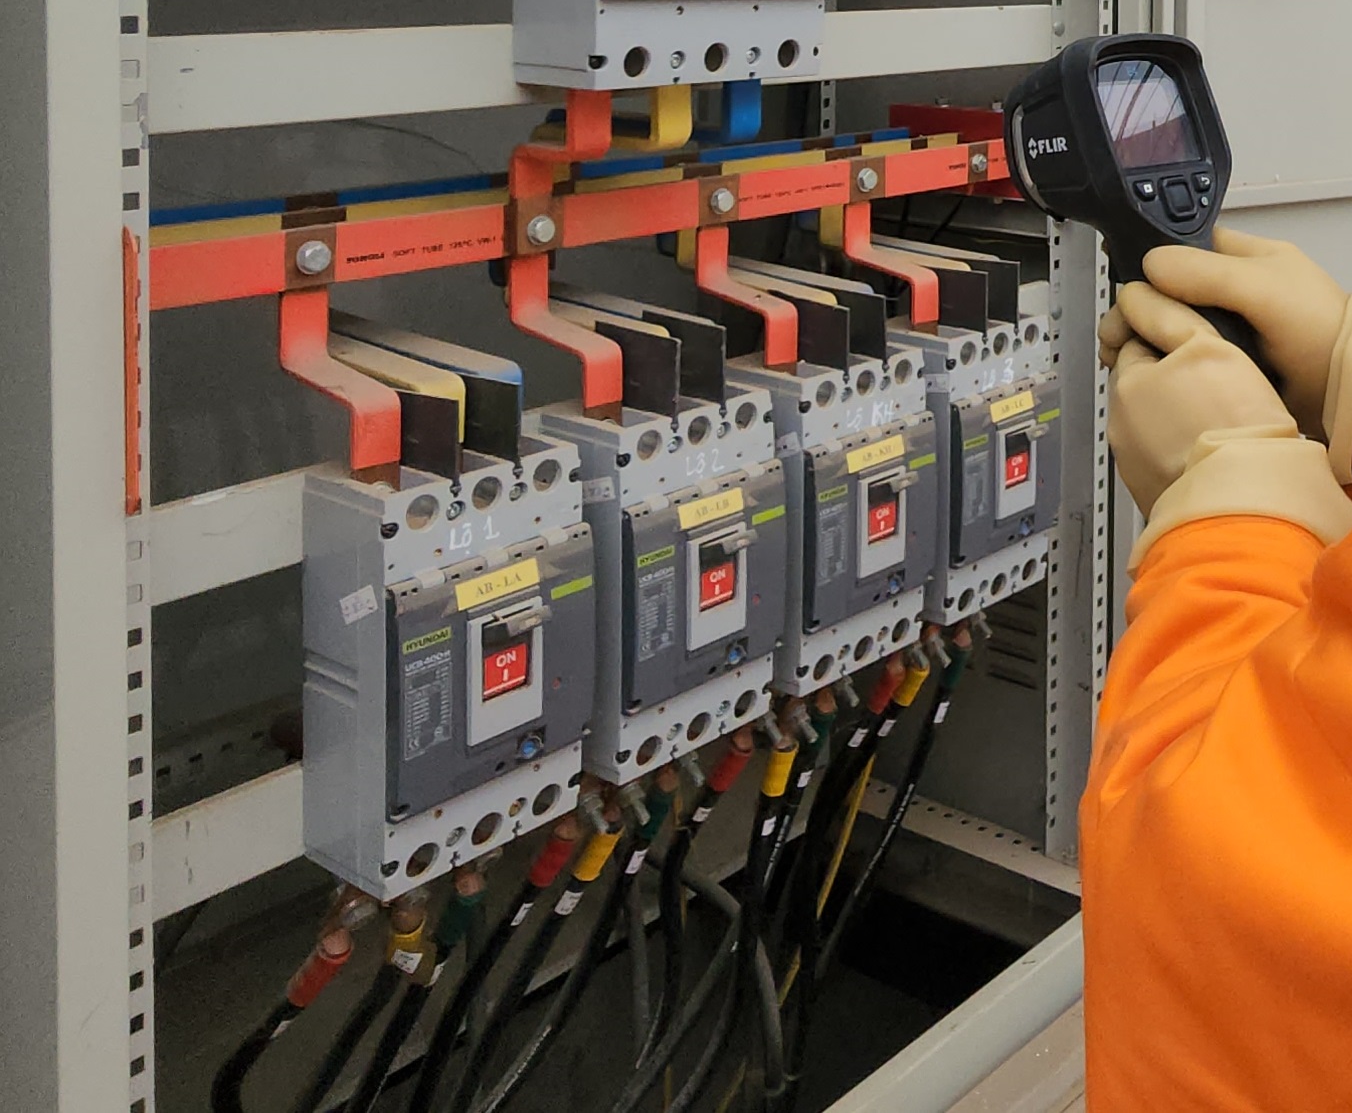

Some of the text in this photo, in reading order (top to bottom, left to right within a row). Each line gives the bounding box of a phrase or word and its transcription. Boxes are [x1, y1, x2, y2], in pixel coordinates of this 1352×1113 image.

[1038, 136, 1068, 155] FLIR
[876, 507, 890, 520] ON
[709, 568, 727, 584] ON
[406, 629, 450, 652] HYUNDAI
[495, 649, 517, 669] ON
